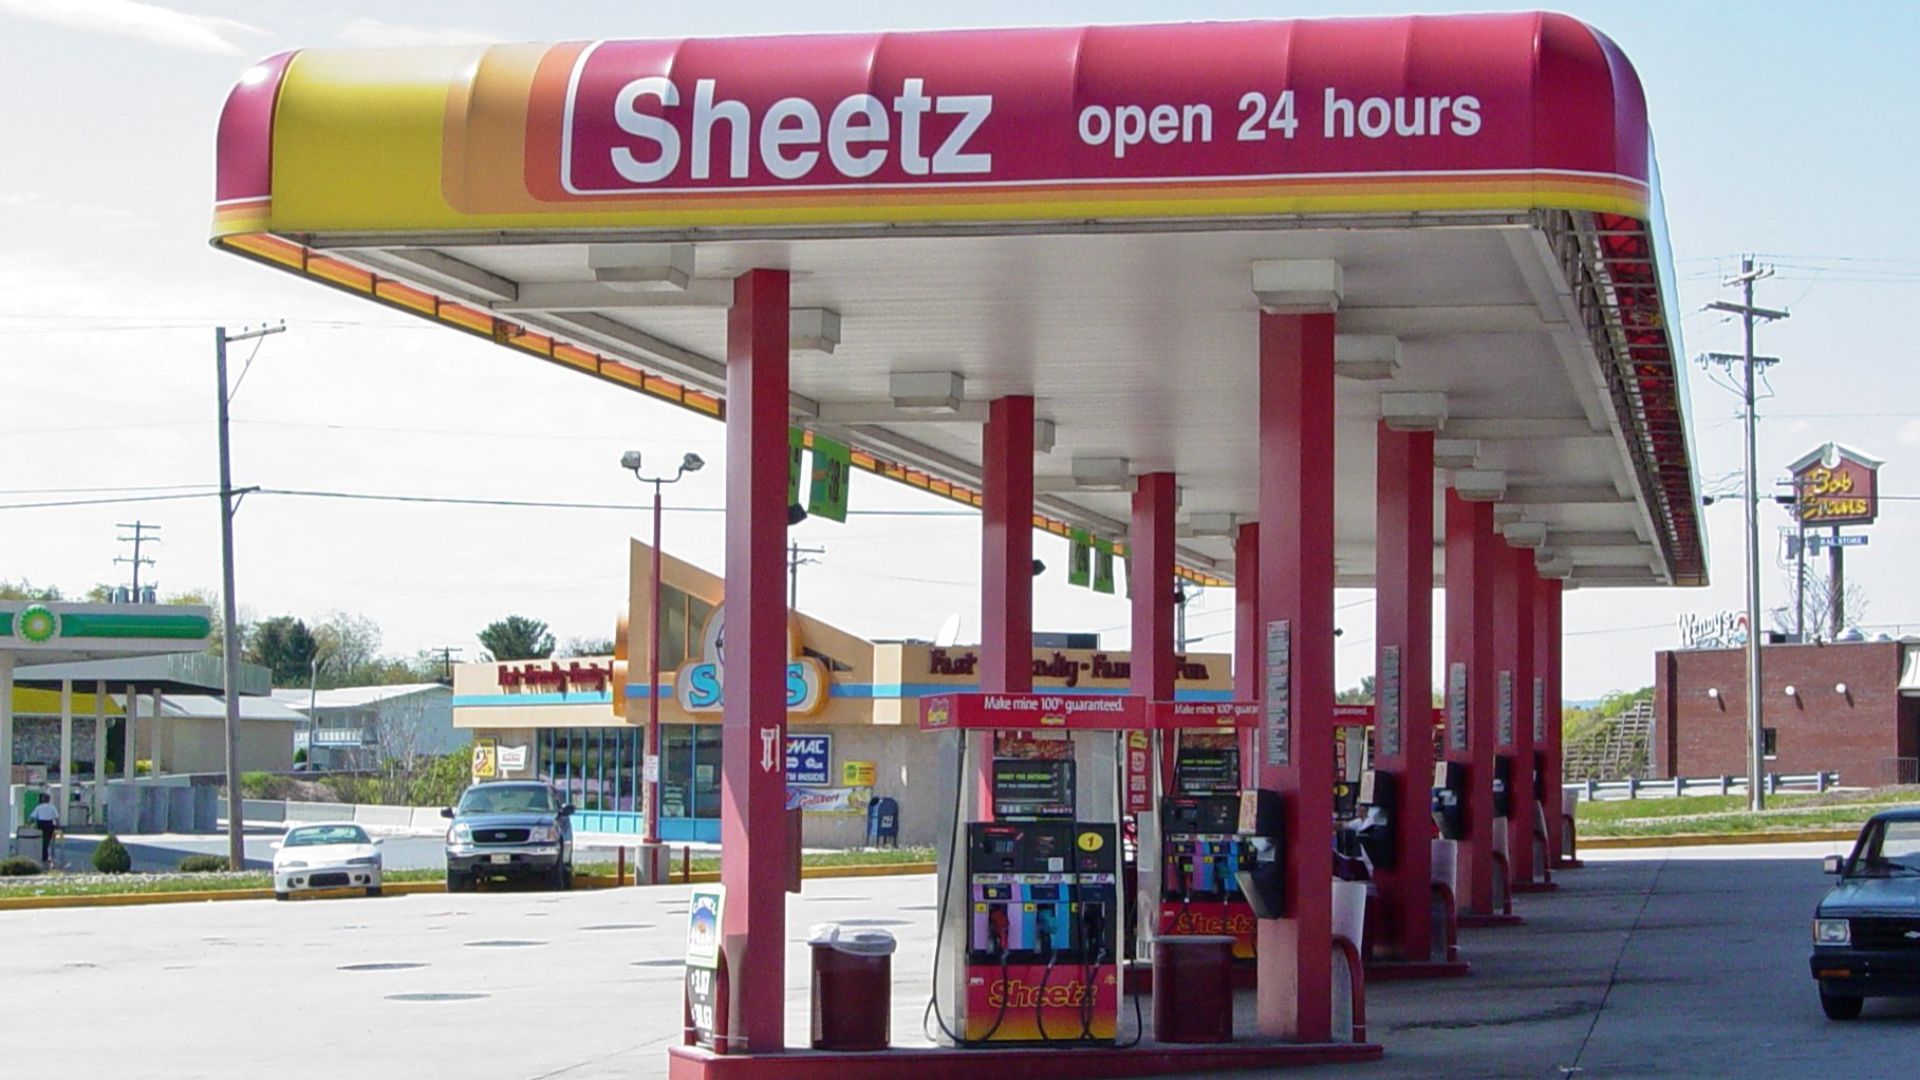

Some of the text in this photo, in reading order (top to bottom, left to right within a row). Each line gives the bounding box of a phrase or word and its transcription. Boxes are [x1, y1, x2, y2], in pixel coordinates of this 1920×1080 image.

[610, 76, 993, 183] Sheetz
[1078, 87, 1482, 158] open 24 hours
[1808, 469, 1852, 493] Bob
[929, 649, 978, 675] Fast
[984, 695, 1012, 711] Make
[1013, 696, 1038, 711] mine
[1174, 703, 1195, 715] Make
[787, 740, 824, 754] MAC
[798, 773, 825, 781] INSIDE
[1177, 911, 1253, 934] Sheetz
[989, 979, 1097, 1008] Sheetz
